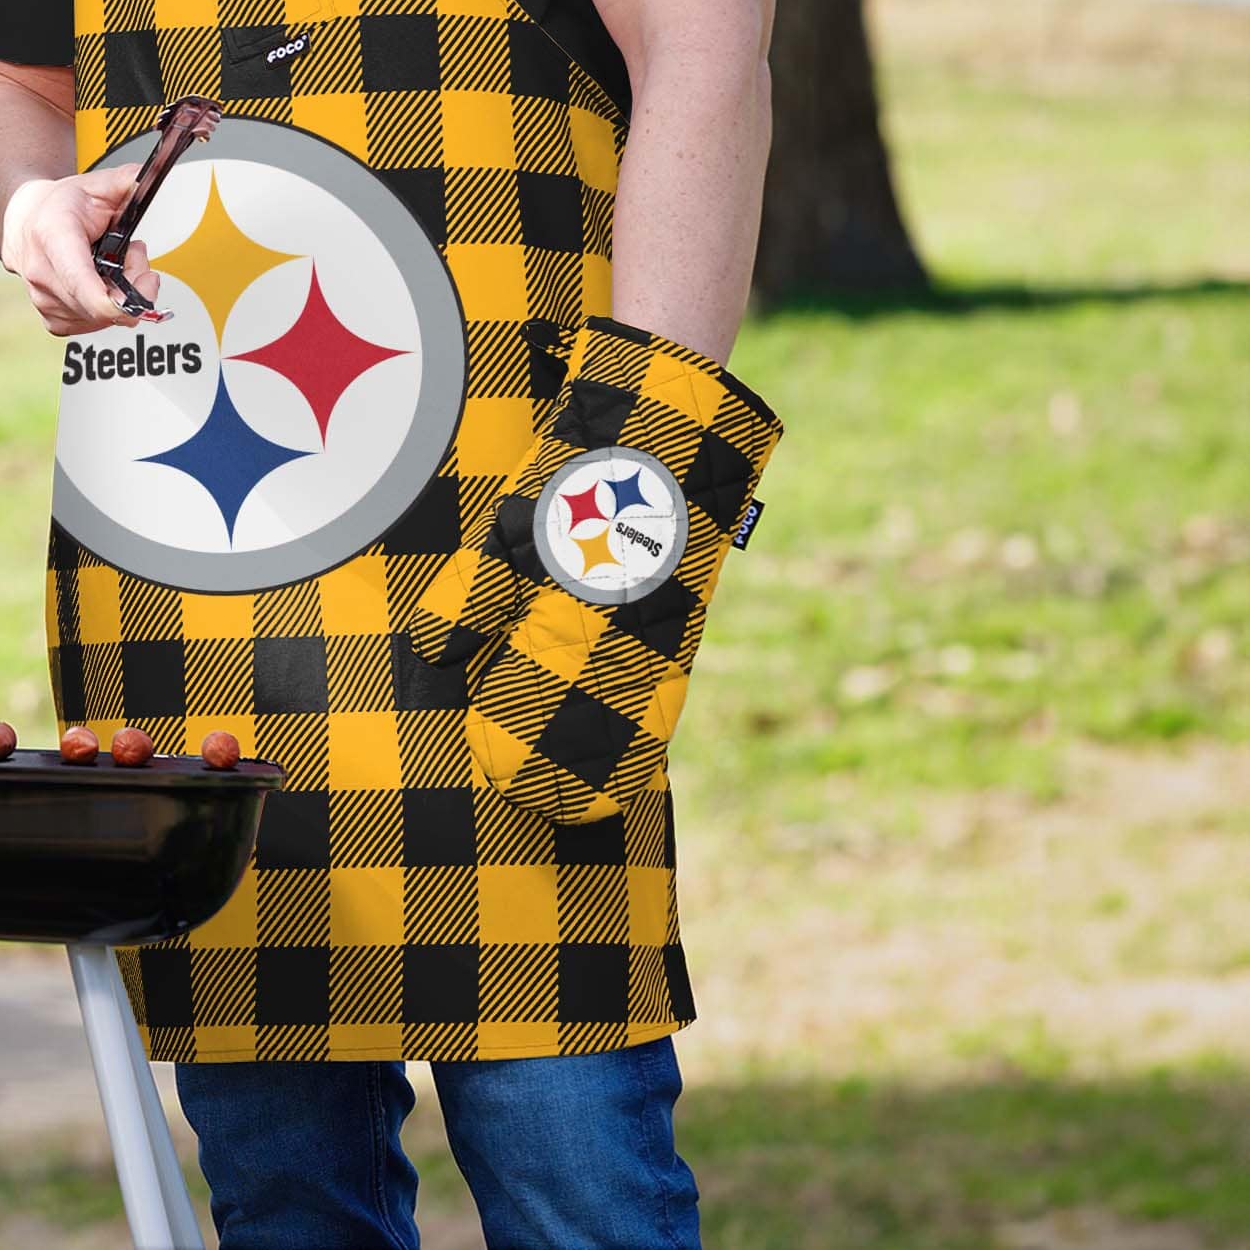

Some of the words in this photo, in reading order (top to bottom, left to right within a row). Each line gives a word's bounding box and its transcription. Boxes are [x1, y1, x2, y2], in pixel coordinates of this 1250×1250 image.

[267, 38, 305, 63] FOCO
[62, 334, 202, 385] Steelers
[615, 522, 663, 557] Steelers
